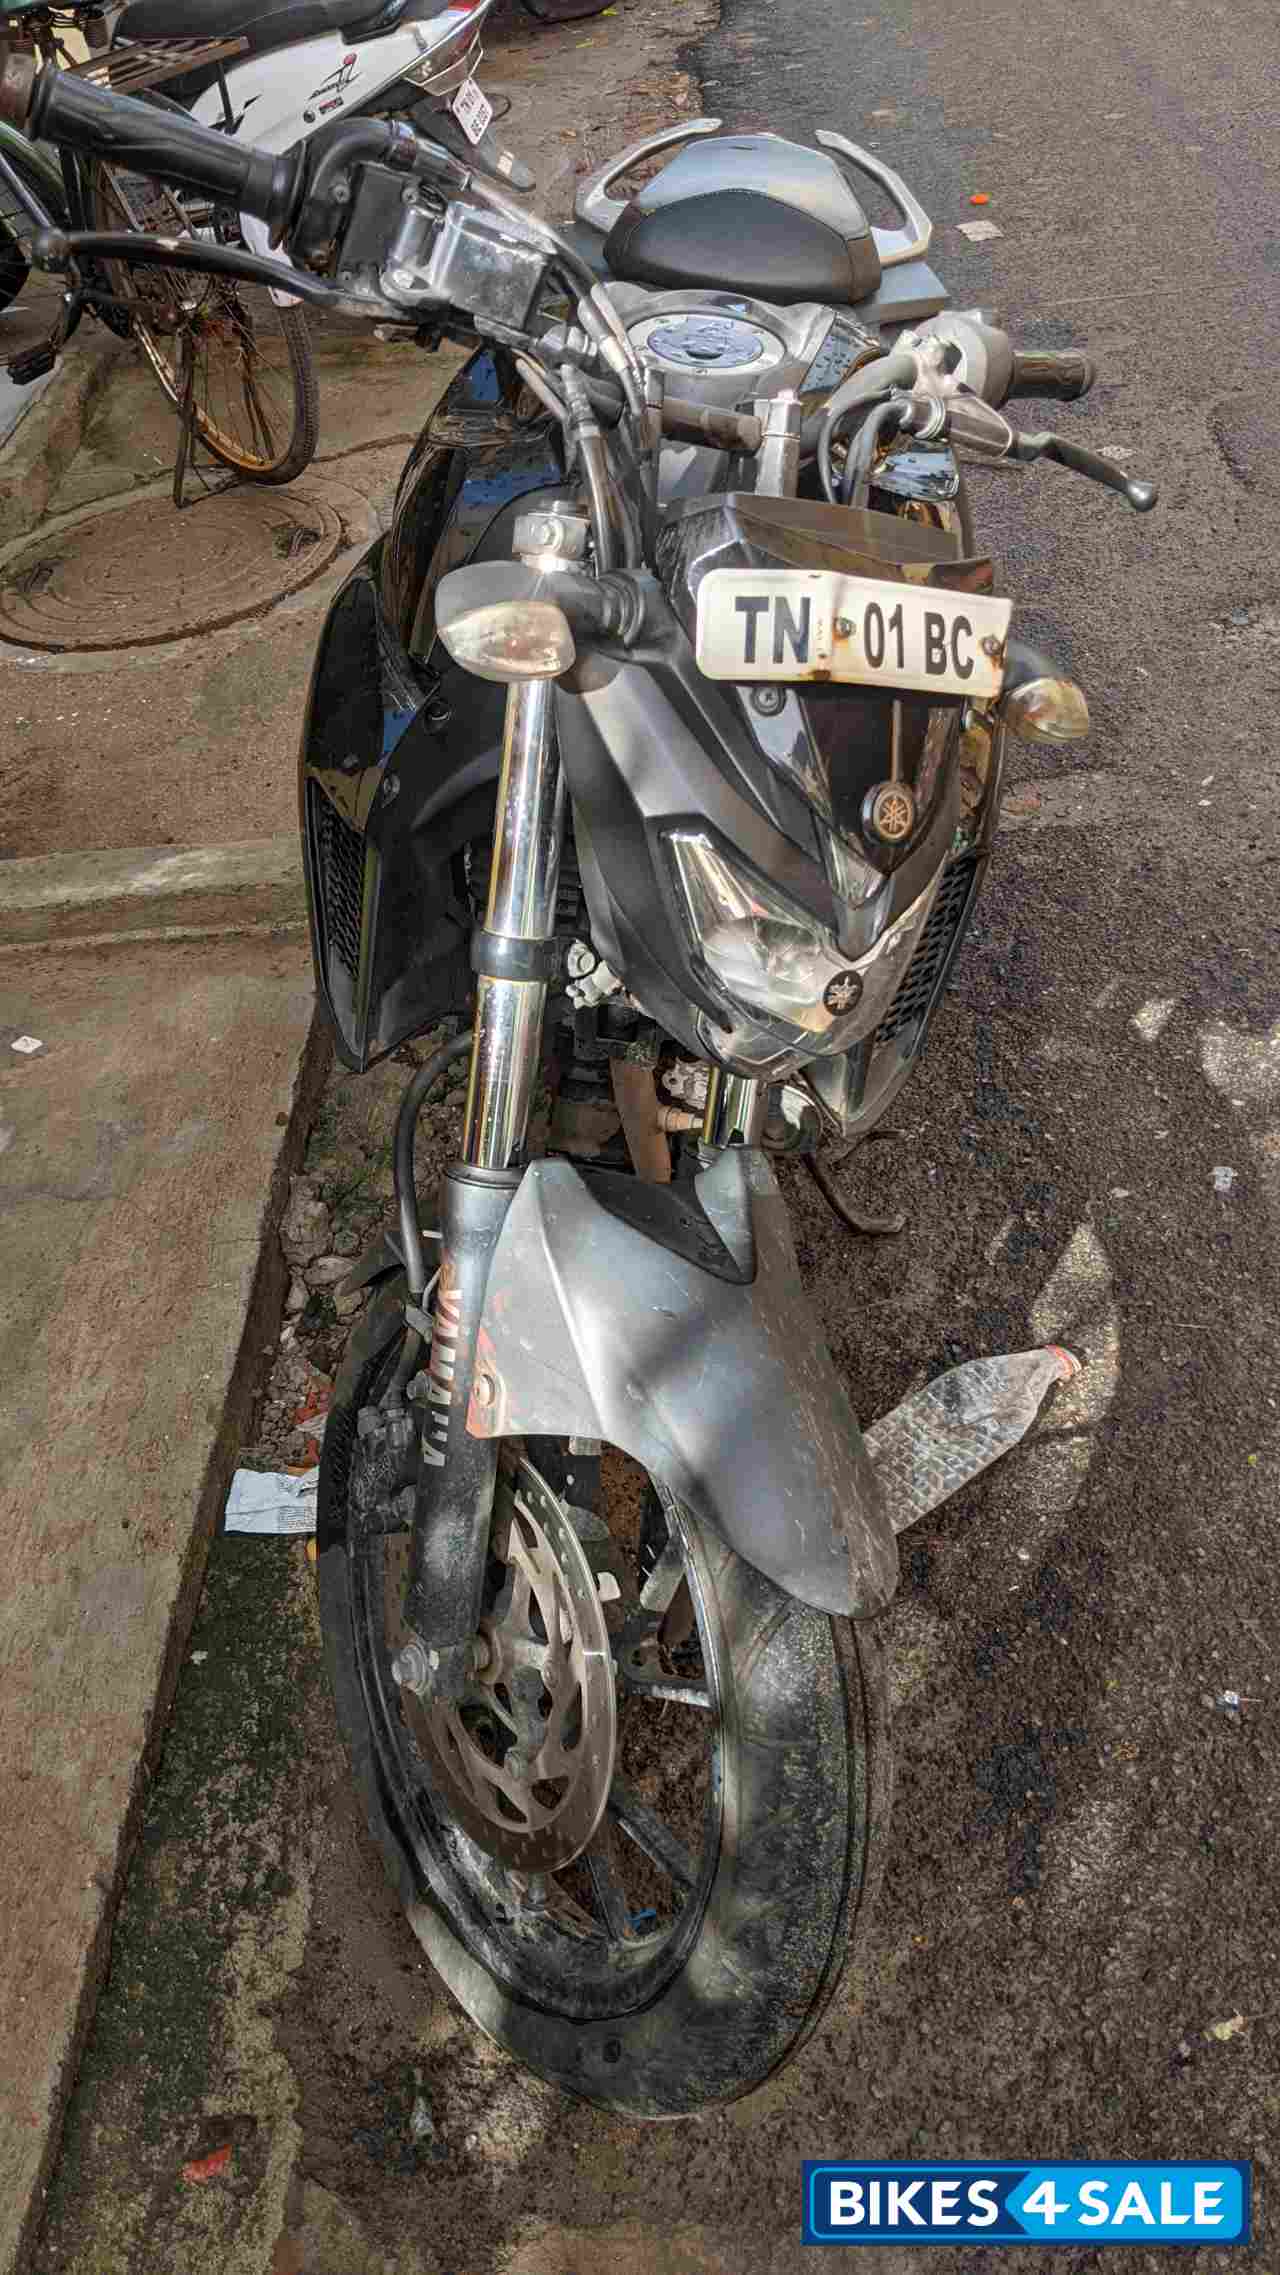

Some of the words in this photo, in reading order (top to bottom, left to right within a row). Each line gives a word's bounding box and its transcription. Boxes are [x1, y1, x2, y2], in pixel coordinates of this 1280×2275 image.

[735, 596, 812, 664] TN
[863, 601, 905, 670] 01
[924, 611, 975, 680] BC
